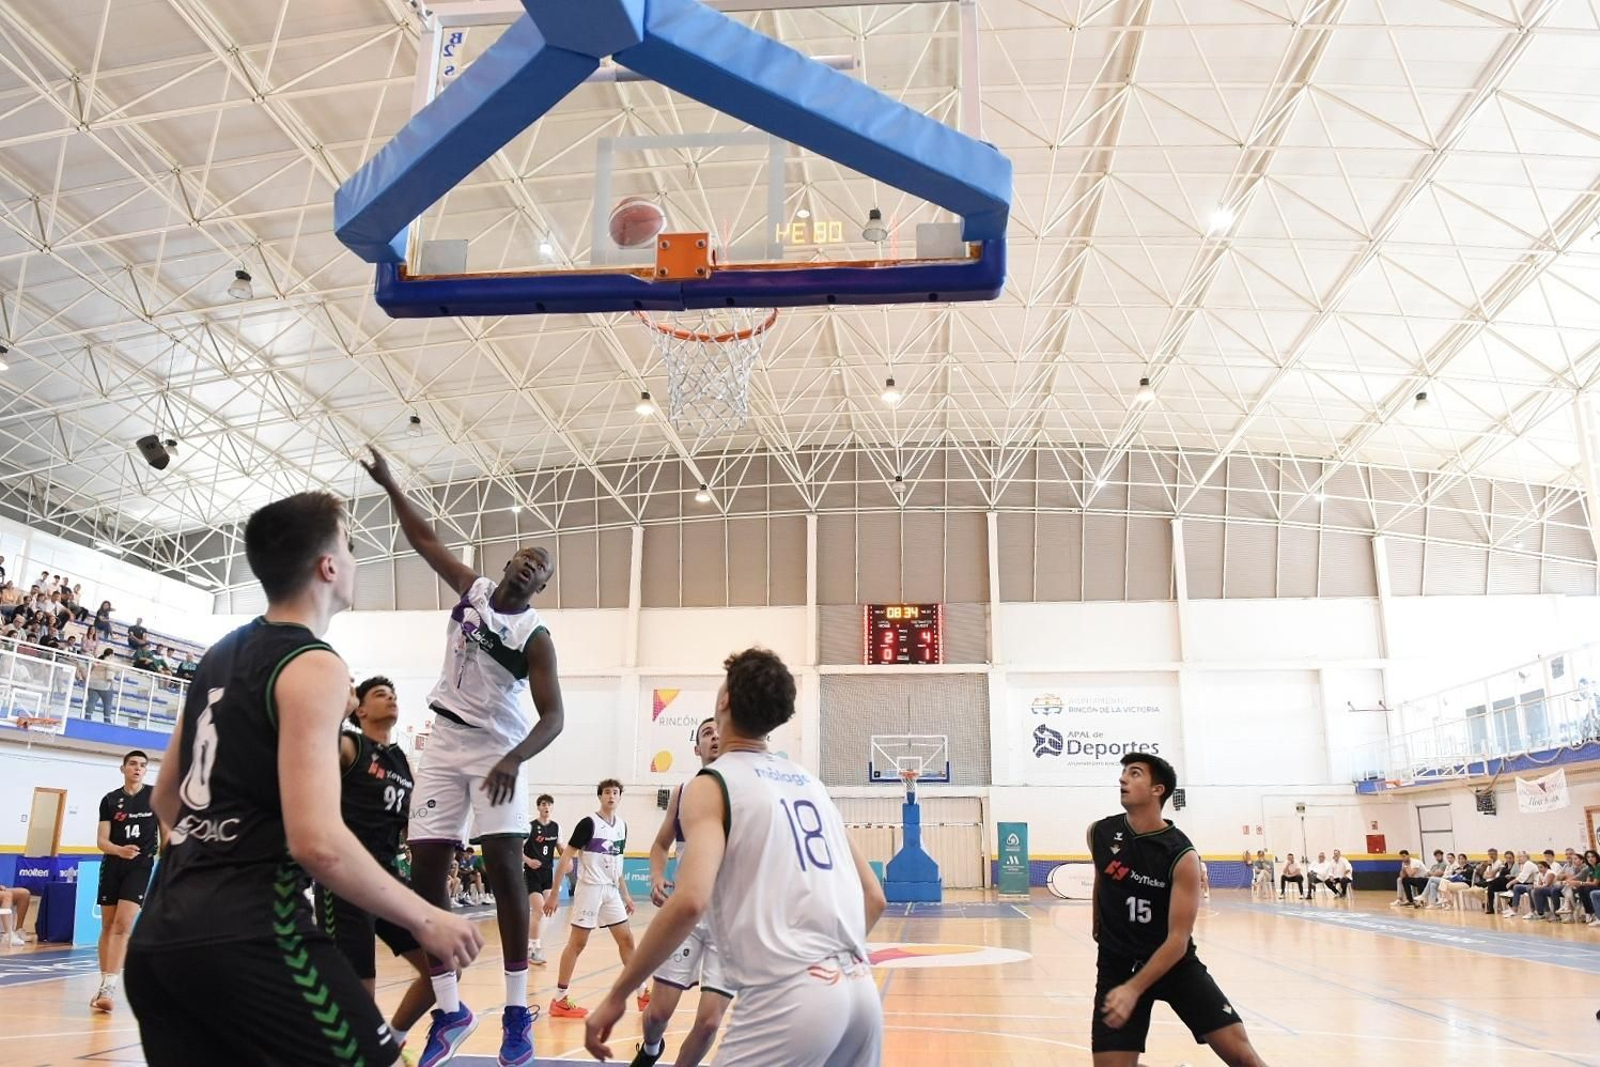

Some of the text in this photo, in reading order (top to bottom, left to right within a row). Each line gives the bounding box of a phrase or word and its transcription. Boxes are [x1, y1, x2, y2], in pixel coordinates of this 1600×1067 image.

[885, 632, 894, 644] 2
[922, 632, 931, 644] 4
[883, 649, 893, 661] 0
[925, 648, 931, 661] 1
[658, 714, 699, 727] RINCÓN
[1066, 740, 1160, 760] Deportes
[124, 823, 141, 839] 14
[779, 797, 834, 872] 18
[19, 868, 50, 878] molten
[1125, 895, 1153, 924] 15
